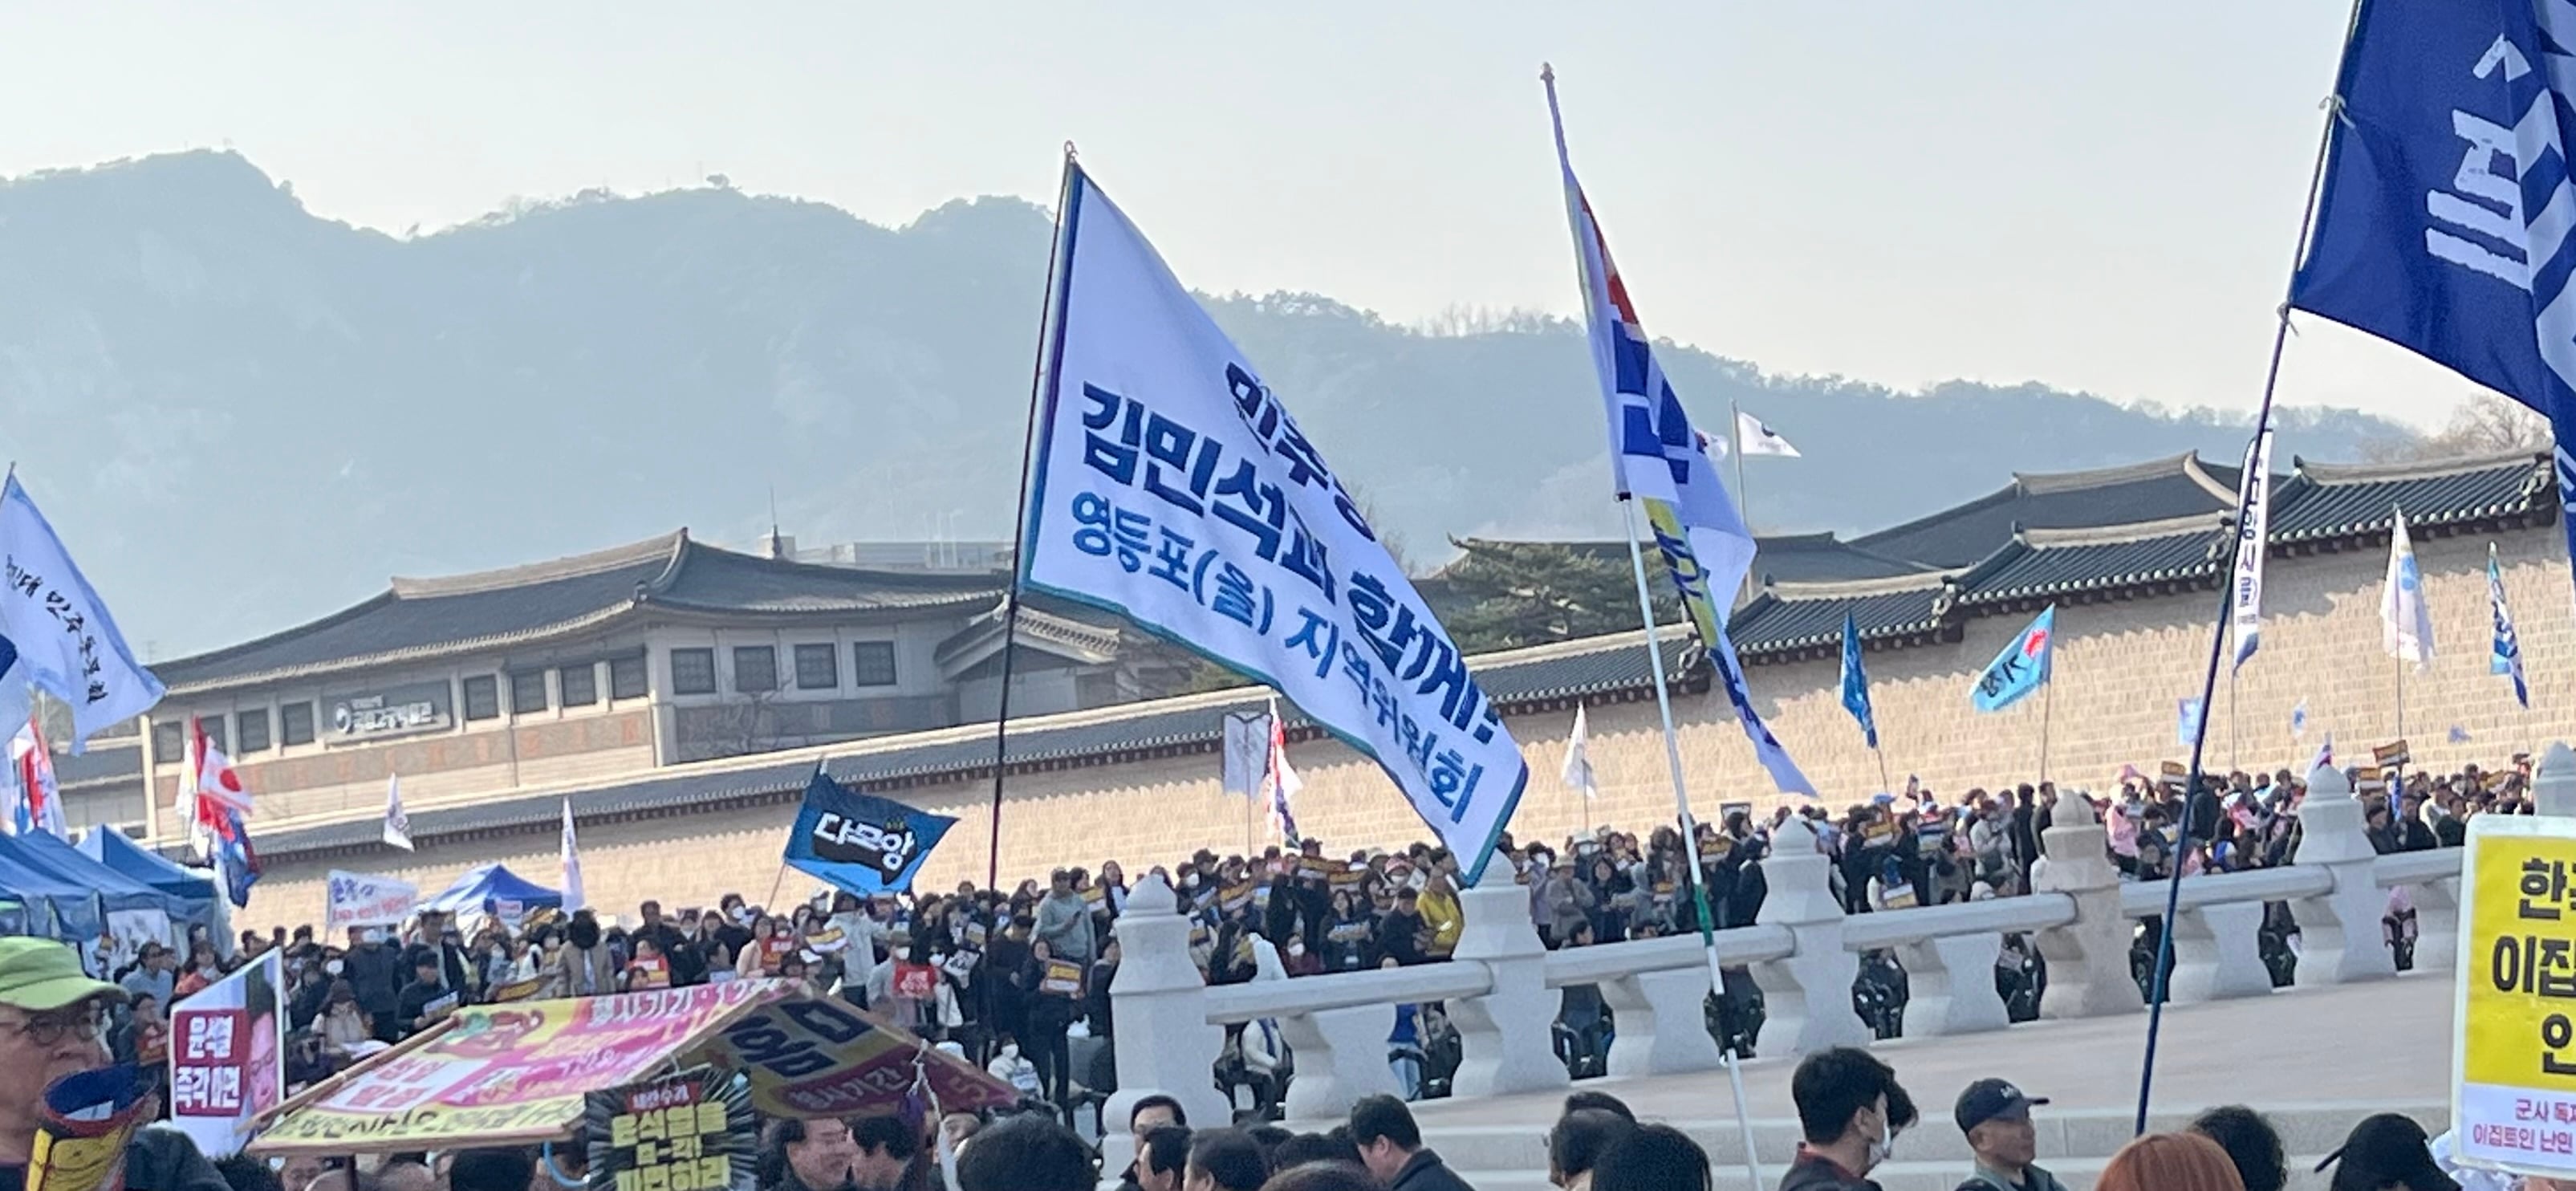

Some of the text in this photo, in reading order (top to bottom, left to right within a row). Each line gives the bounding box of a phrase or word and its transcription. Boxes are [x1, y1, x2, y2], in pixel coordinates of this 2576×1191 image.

[1083, 380, 1337, 606] 김민석과
[1072, 491, 1485, 825] 영등포(을) 지역위원회
[814, 811, 915, 871] 다모앙
[2518, 856, 2576, 921] 한
[2472, 1123, 2535, 1152] 이집트인
